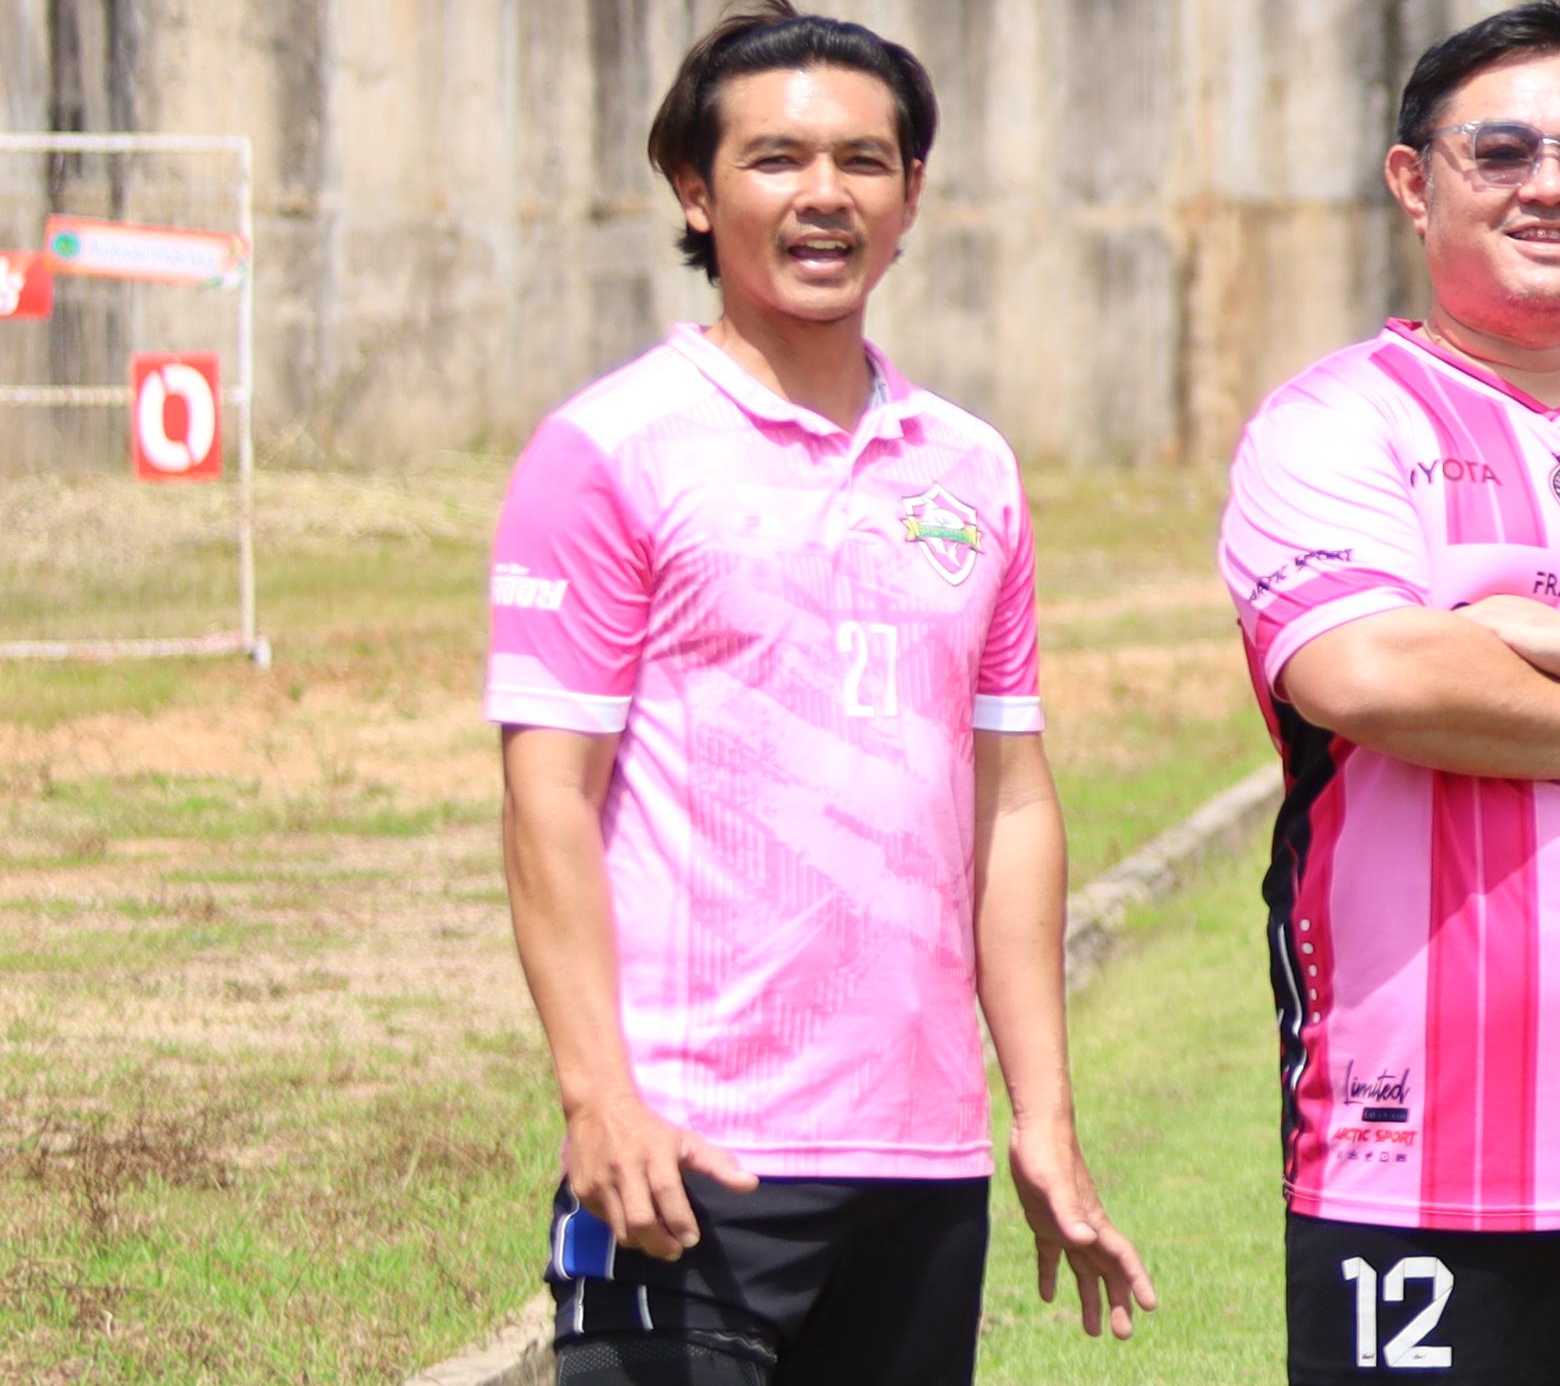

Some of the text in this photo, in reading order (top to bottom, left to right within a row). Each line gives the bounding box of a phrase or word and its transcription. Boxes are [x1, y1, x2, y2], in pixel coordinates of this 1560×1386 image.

[1410, 459, 1503, 488] YOTA
[837, 620, 897, 717] 27
[1342, 1059, 1411, 1107] Limited
[1342, 1256, 1454, 1368] 12
